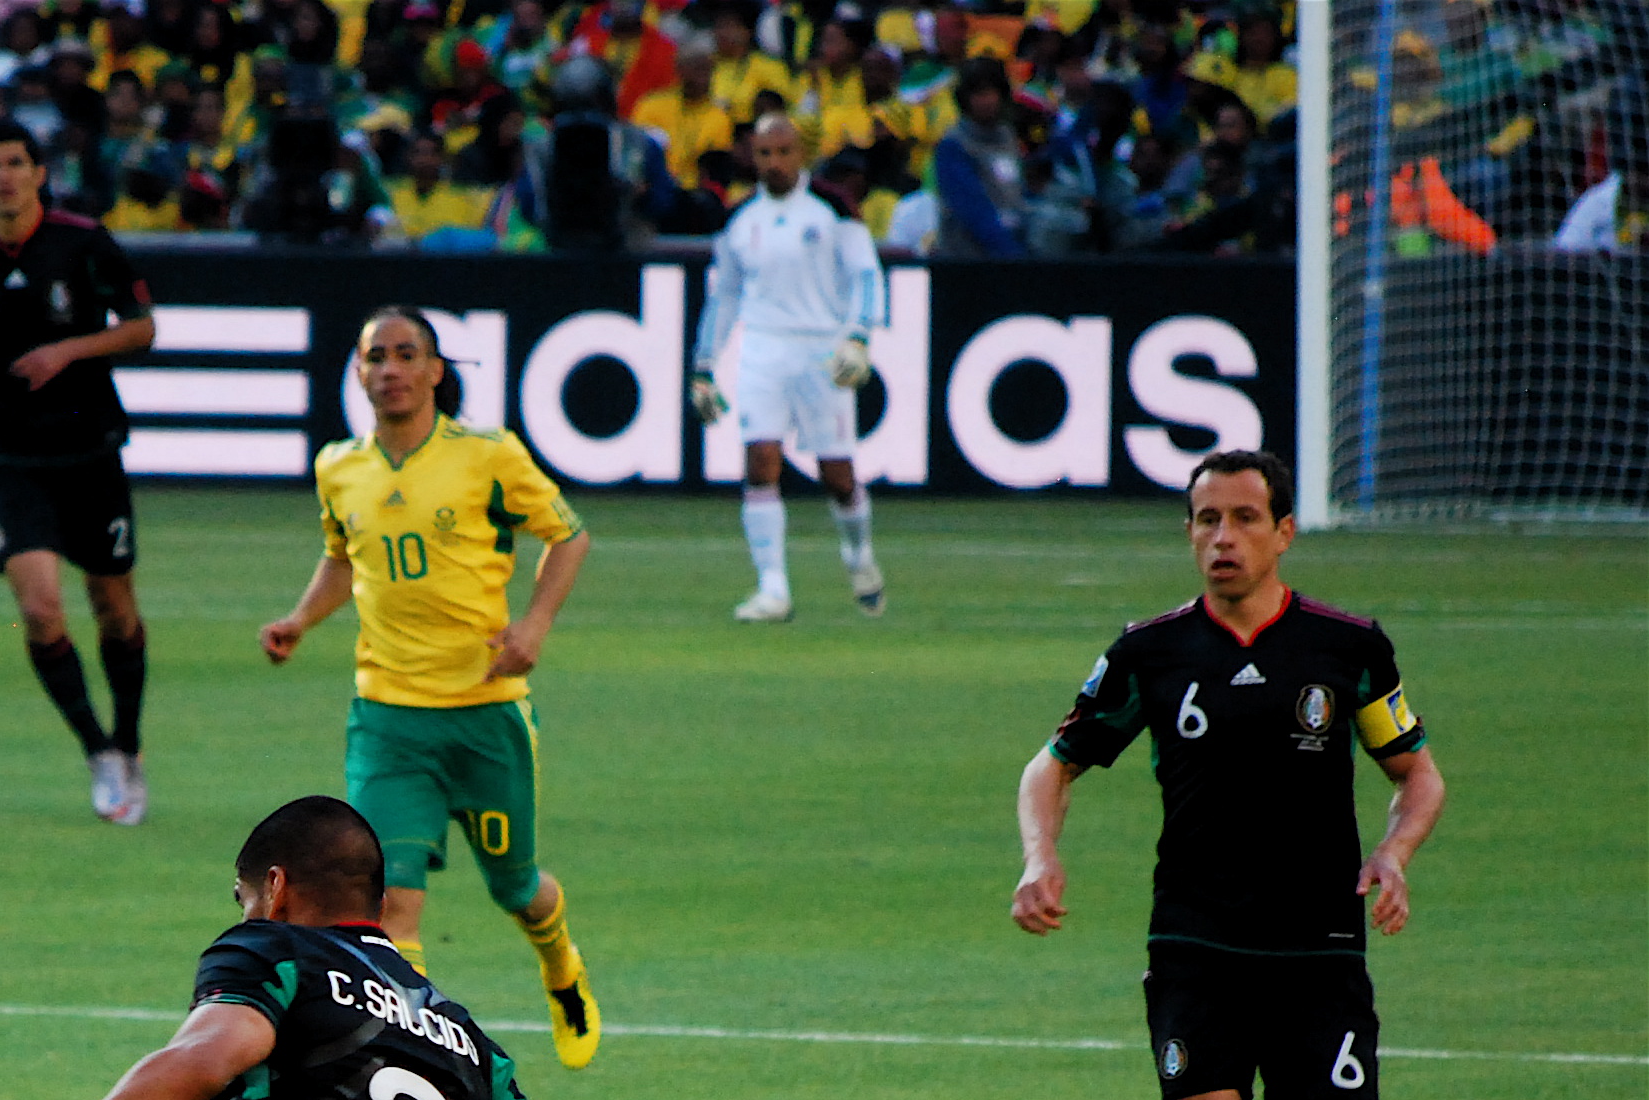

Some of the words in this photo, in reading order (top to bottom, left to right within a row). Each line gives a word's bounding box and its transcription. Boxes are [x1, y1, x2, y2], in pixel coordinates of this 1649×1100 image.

[107, 516, 130, 557] 2
[382, 532, 429, 582] 10
[1177, 681, 1208, 739] 6
[1332, 1031, 1365, 1089] 6
